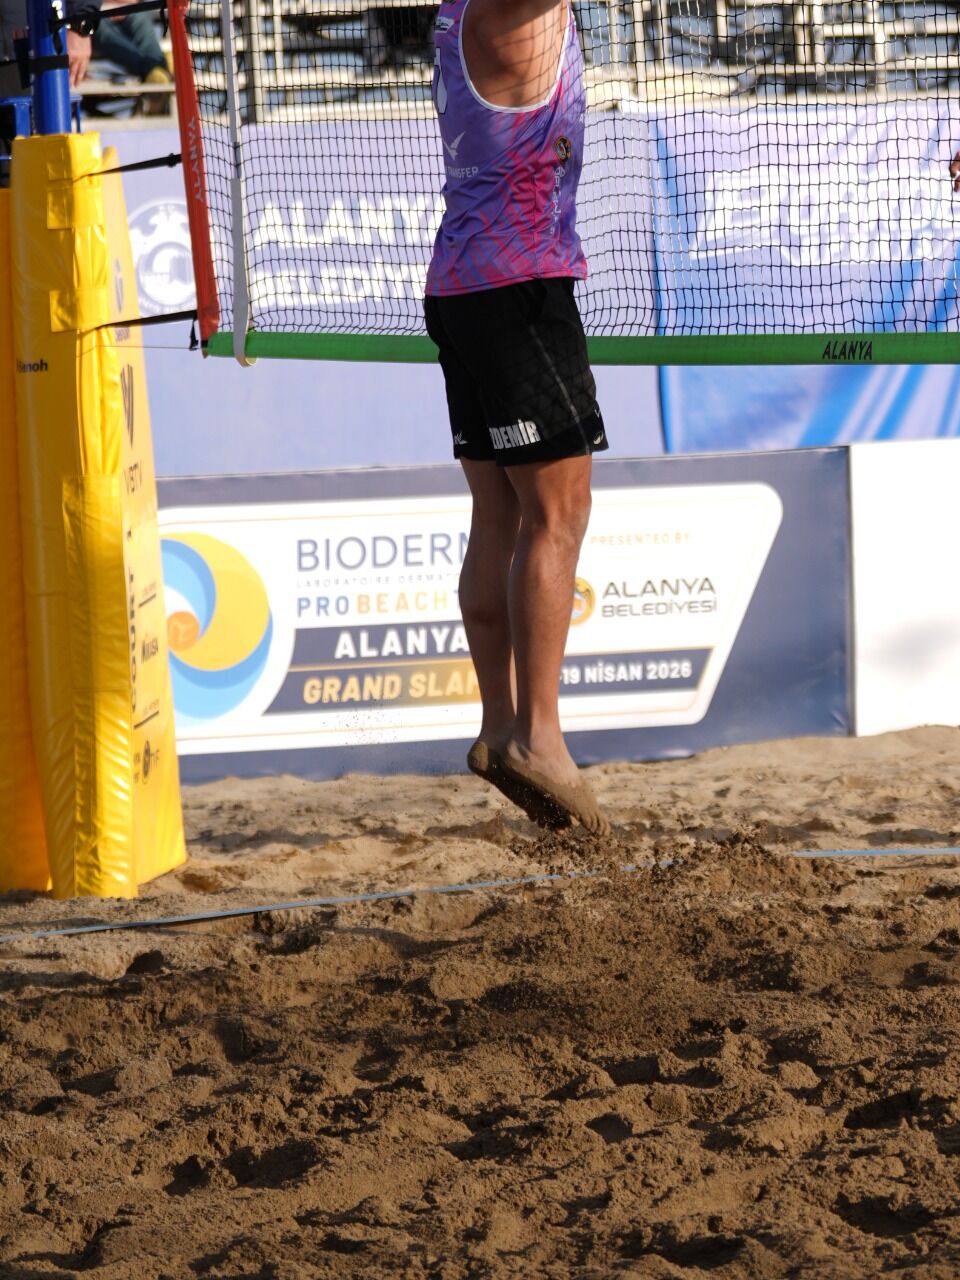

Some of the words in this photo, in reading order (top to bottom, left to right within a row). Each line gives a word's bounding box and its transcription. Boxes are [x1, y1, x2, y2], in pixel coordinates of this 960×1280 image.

[822, 341, 873, 360] ALANYA
[489, 418, 541, 450] DEMİR
[602, 577, 717, 600] ALANYA
[601, 597, 718, 618] BELEDİYESİ
[334, 625, 470, 659] ALANYA
[584, 659, 643, 683] NİSAN
[646, 659, 692, 680] 2026
[303, 675, 402, 705] GRAND
